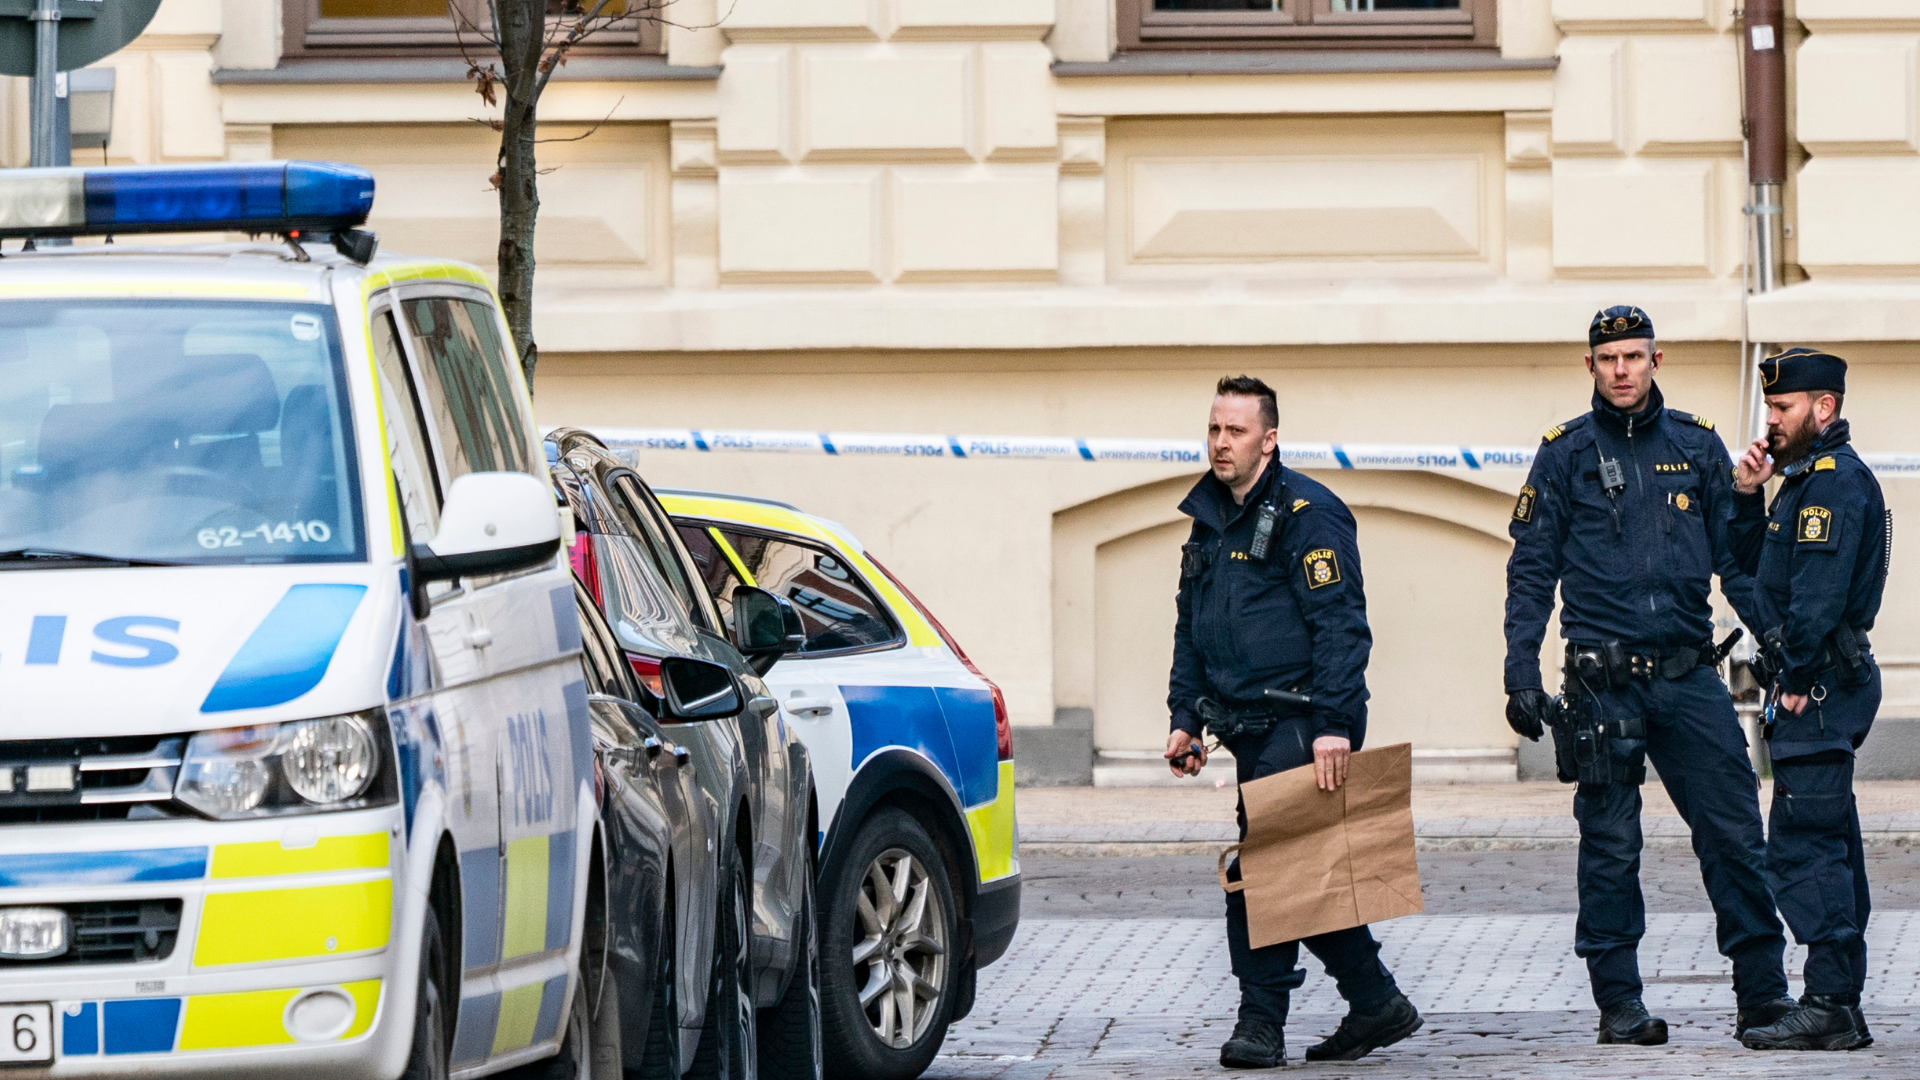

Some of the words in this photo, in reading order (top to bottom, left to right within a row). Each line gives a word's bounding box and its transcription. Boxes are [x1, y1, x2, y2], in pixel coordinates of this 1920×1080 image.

[903, 444, 944, 456] POLIS
[970, 441, 1011, 455] POLIS
[1160, 450, 1201, 462] POLIS
[1416, 455, 1457, 467] POLIS
[1483, 452, 1523, 465] POLIS
[1655, 462, 1689, 471] POLIS
[1802, 508, 1829, 519] POLIS
[197, 519, 331, 550] 62-1410
[1306, 551, 1333, 565] POLIS
[506, 707, 554, 828] POLIS
[12, 1012, 37, 1052] 6
